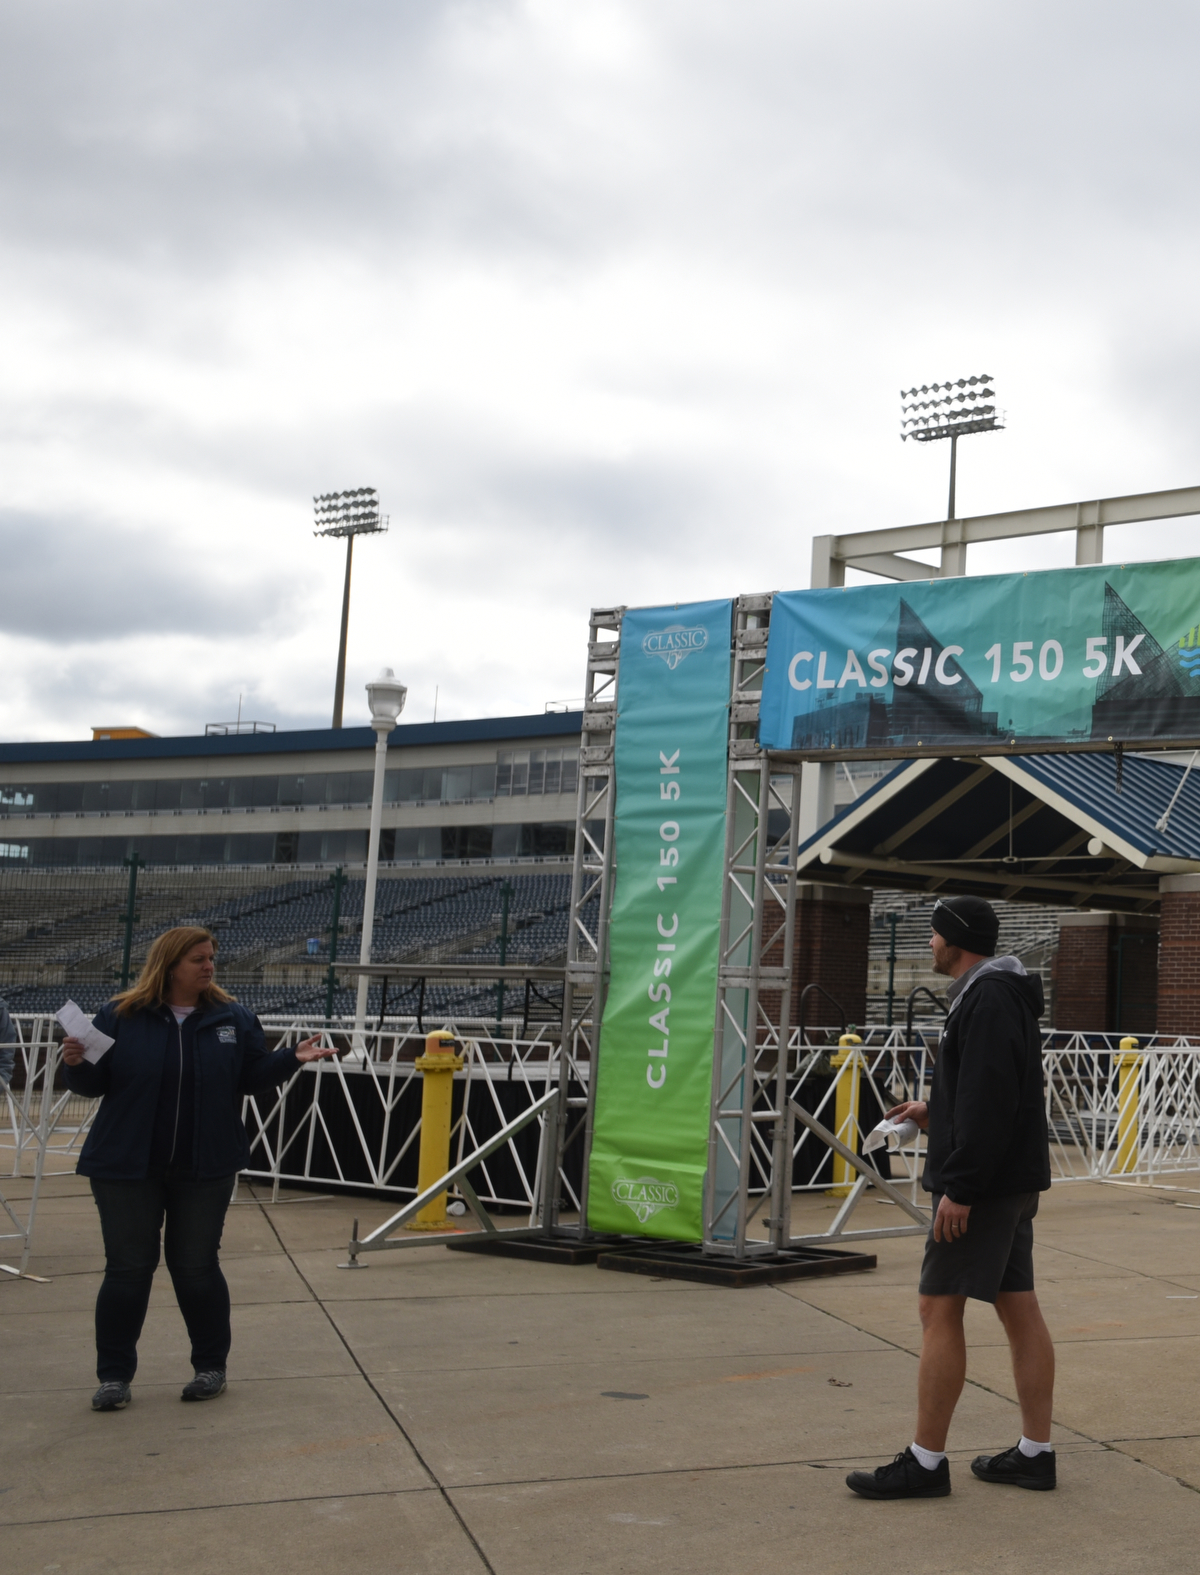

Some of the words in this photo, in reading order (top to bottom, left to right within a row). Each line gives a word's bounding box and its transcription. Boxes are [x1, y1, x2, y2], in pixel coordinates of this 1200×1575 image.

[647, 630, 703, 651] CLASSIC
[788, 646, 963, 690] CLASSIC
[983, 638, 1064, 684] 150
[1081, 633, 1144, 679] 5K
[660, 748, 680, 801] 5K
[657, 820, 679, 892] 150
[646, 914, 678, 1089] CLASSIC
[616, 1183, 676, 1204] CLASSIC
